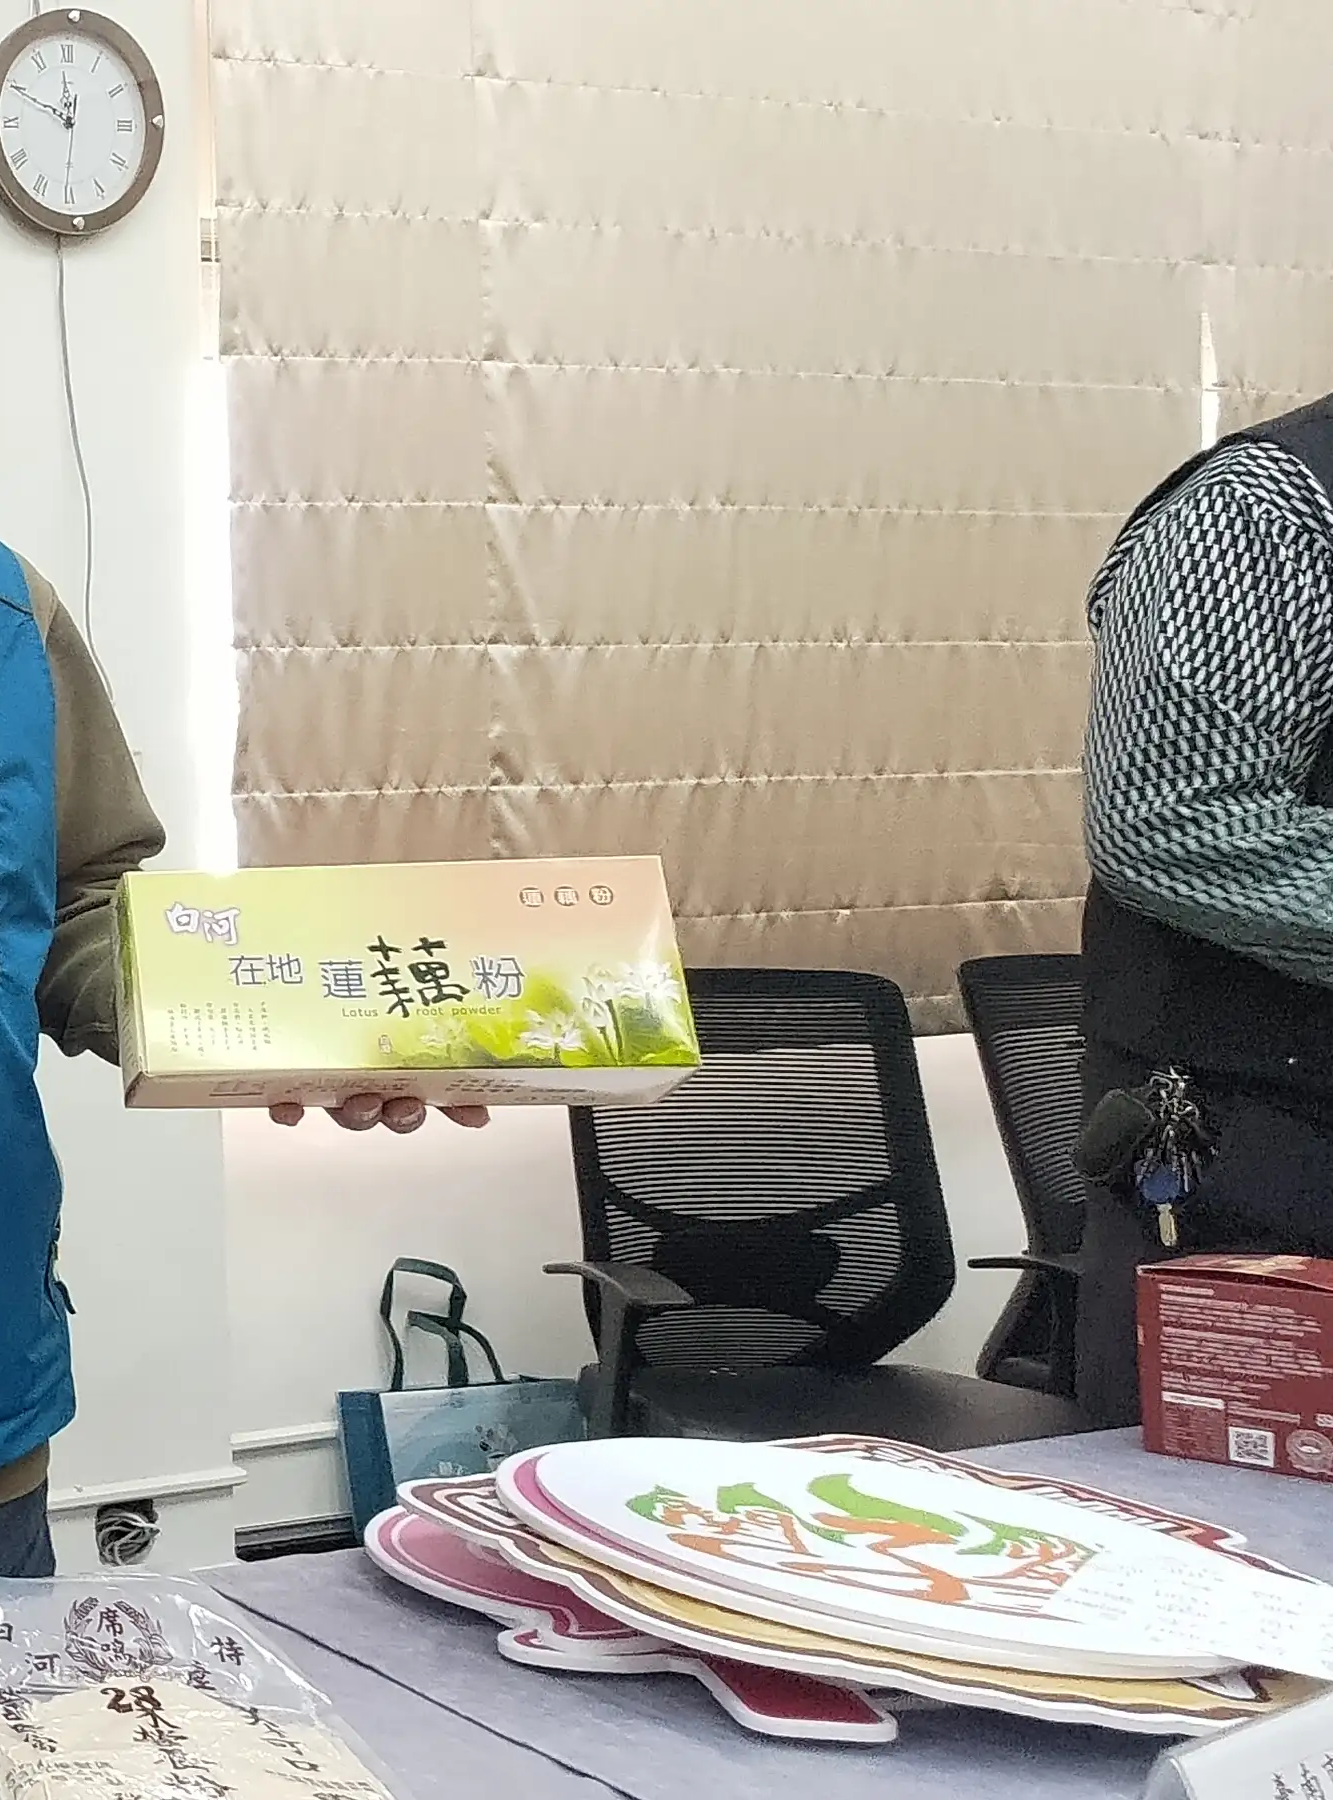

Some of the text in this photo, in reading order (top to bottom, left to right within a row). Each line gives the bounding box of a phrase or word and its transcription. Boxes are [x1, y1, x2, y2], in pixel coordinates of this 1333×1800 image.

[165, 901, 241, 945] 白河
[228, 954, 304, 987] 在地
[317, 935, 526, 1019] 蓮藕粉
[341, 1005, 503, 1018] Lotus root powder
